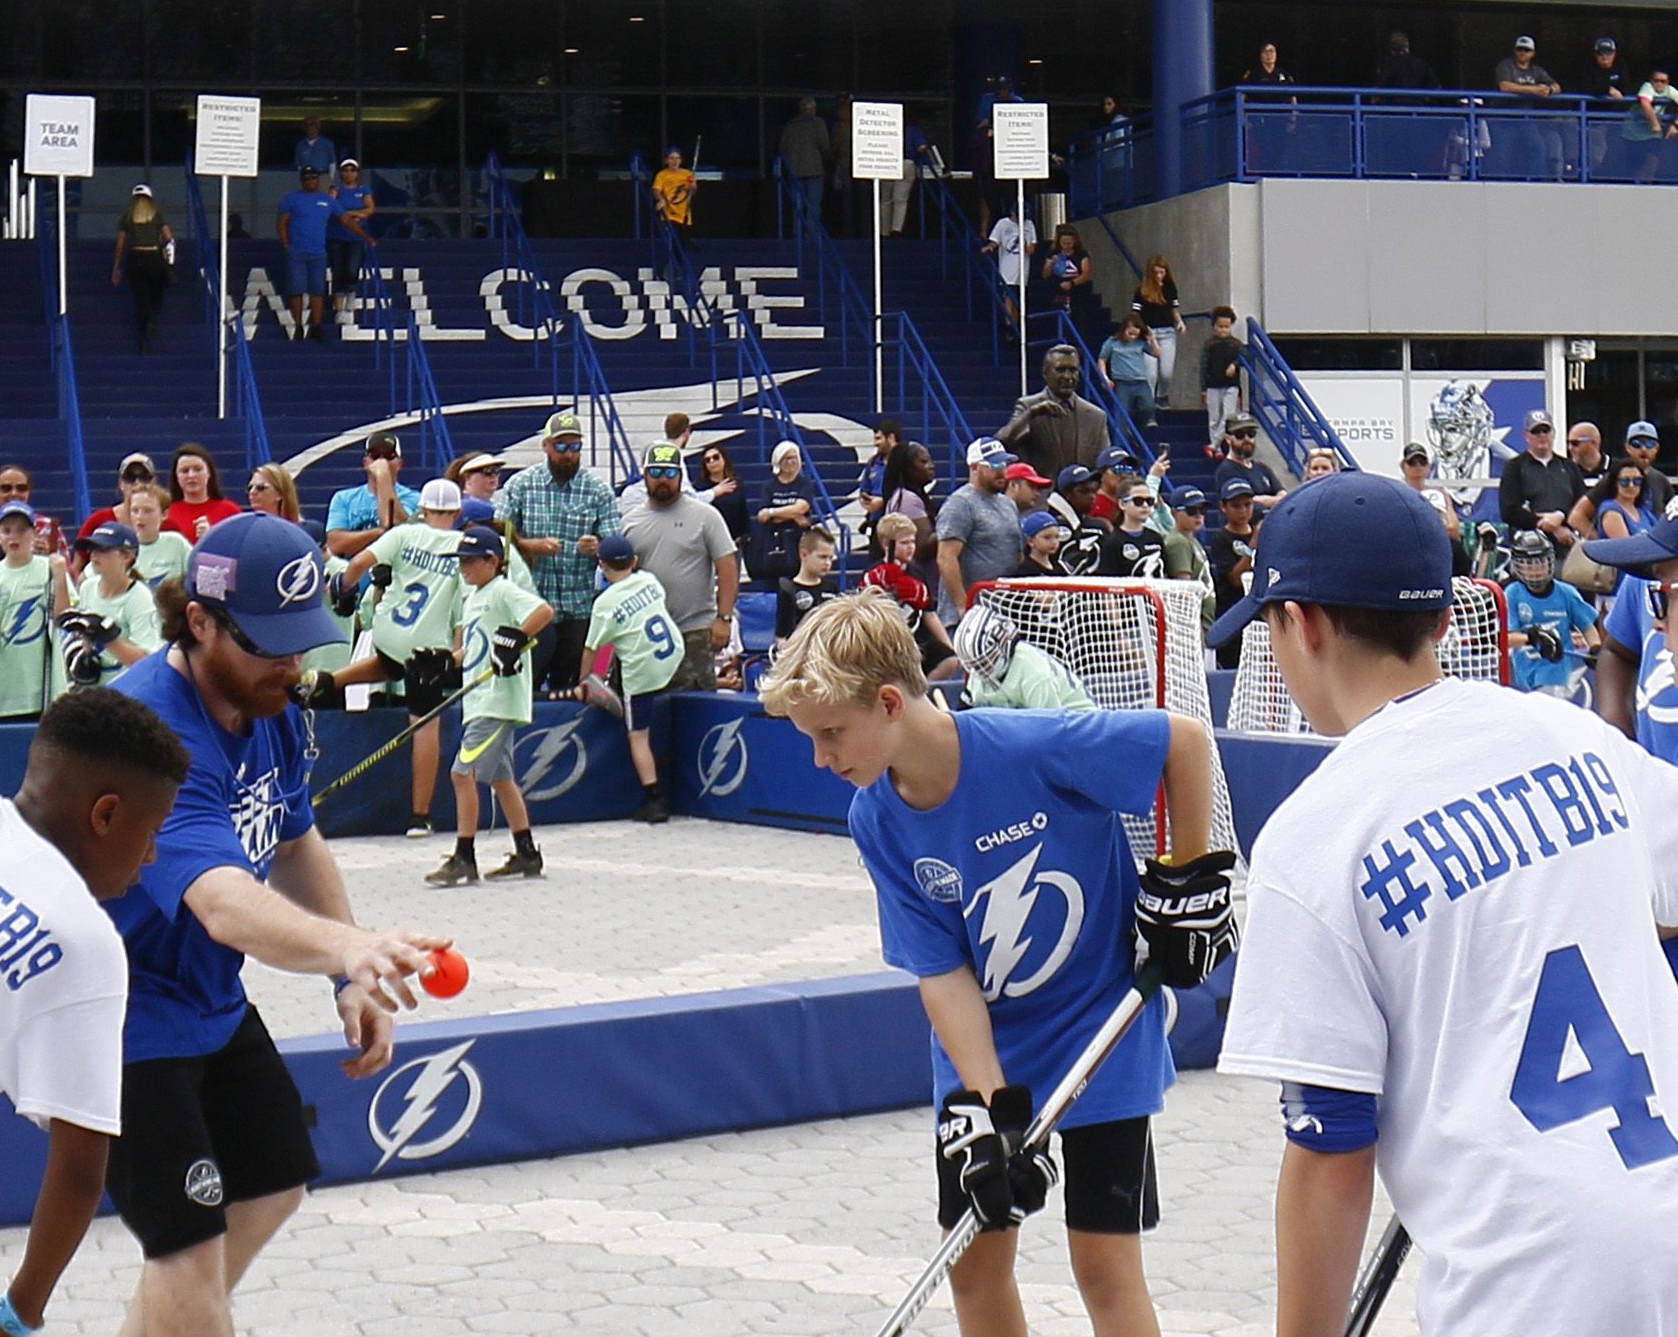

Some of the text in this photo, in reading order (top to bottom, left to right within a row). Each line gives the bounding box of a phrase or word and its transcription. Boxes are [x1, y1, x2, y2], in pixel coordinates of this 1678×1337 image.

[40, 122, 79, 136] TEAM
[40, 136, 78, 149] AREA
[200, 266, 825, 341] WELCOME
[1336, 428, 1394, 441] PORTS
[391, 582, 429, 627] 3
[644, 614, 676, 661] 9
[975, 821, 1035, 853] CHASE
[1360, 750, 1630, 939] #HDITB19
